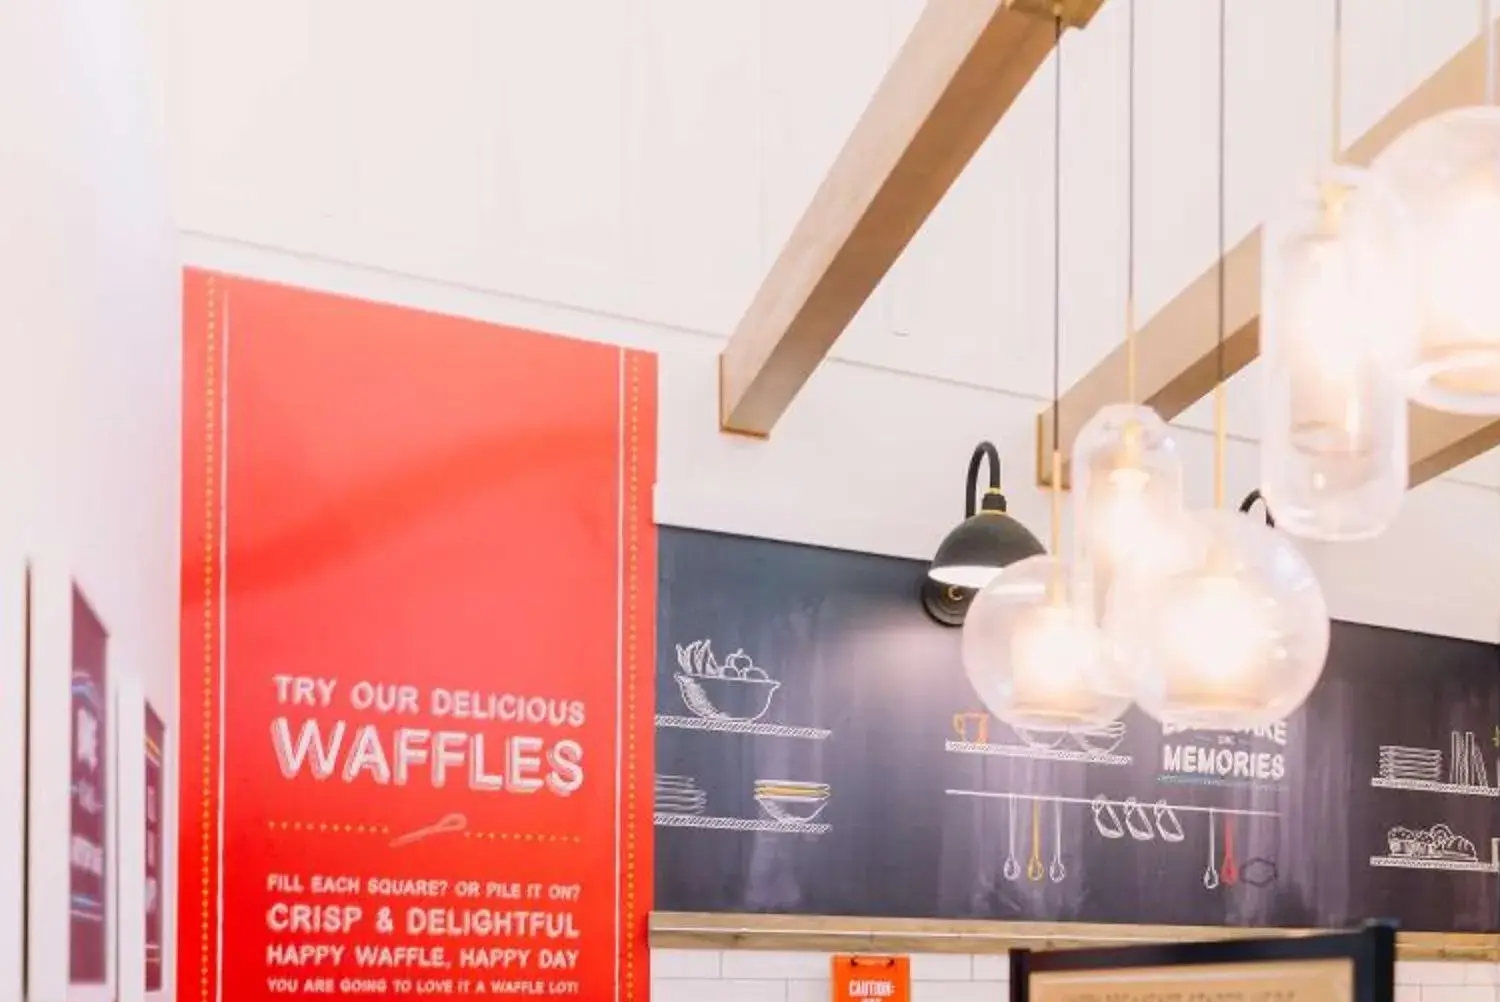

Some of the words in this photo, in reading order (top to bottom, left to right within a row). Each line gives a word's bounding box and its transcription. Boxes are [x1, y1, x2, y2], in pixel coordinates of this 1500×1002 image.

[273, 674, 337, 706] TRY
[350, 680, 419, 714] OUR
[431, 687, 585, 727] DELICIOUS
[271, 716, 586, 797] WAFFLES
[1162, 743, 1286, 781] MEMORIES
[267, 873, 305, 893] FILL
[310, 875, 361, 894] EACH
[367, 877, 449, 897] SQUARE?
[454, 880, 481, 897] OR
[485, 881, 521, 900] PILE
[526, 883, 543, 900] IT
[548, 883, 581, 900] ON?
[266, 902, 363, 933] CRISP
[375, 906, 394, 934] &
[406, 906, 580, 939] DELIGHTFUL
[266, 943, 345, 966] HAPPY
[354, 945, 451, 969] WAFFLE,
[459, 947, 531, 969] HAPPY
[538, 948, 579, 969] DAY
[267, 977, 299, 993] YOU
[303, 978, 335, 993] ARE
[339, 977, 388, 993] GOING
[392, 978, 413, 993] TO
[415, 978, 453, 994] LOVE
[457, 979, 471, 993] IT
[475, 980, 486, 993] A
[490, 979, 545, 995] WAFFLE
[548, 979, 579, 995] LOT!
